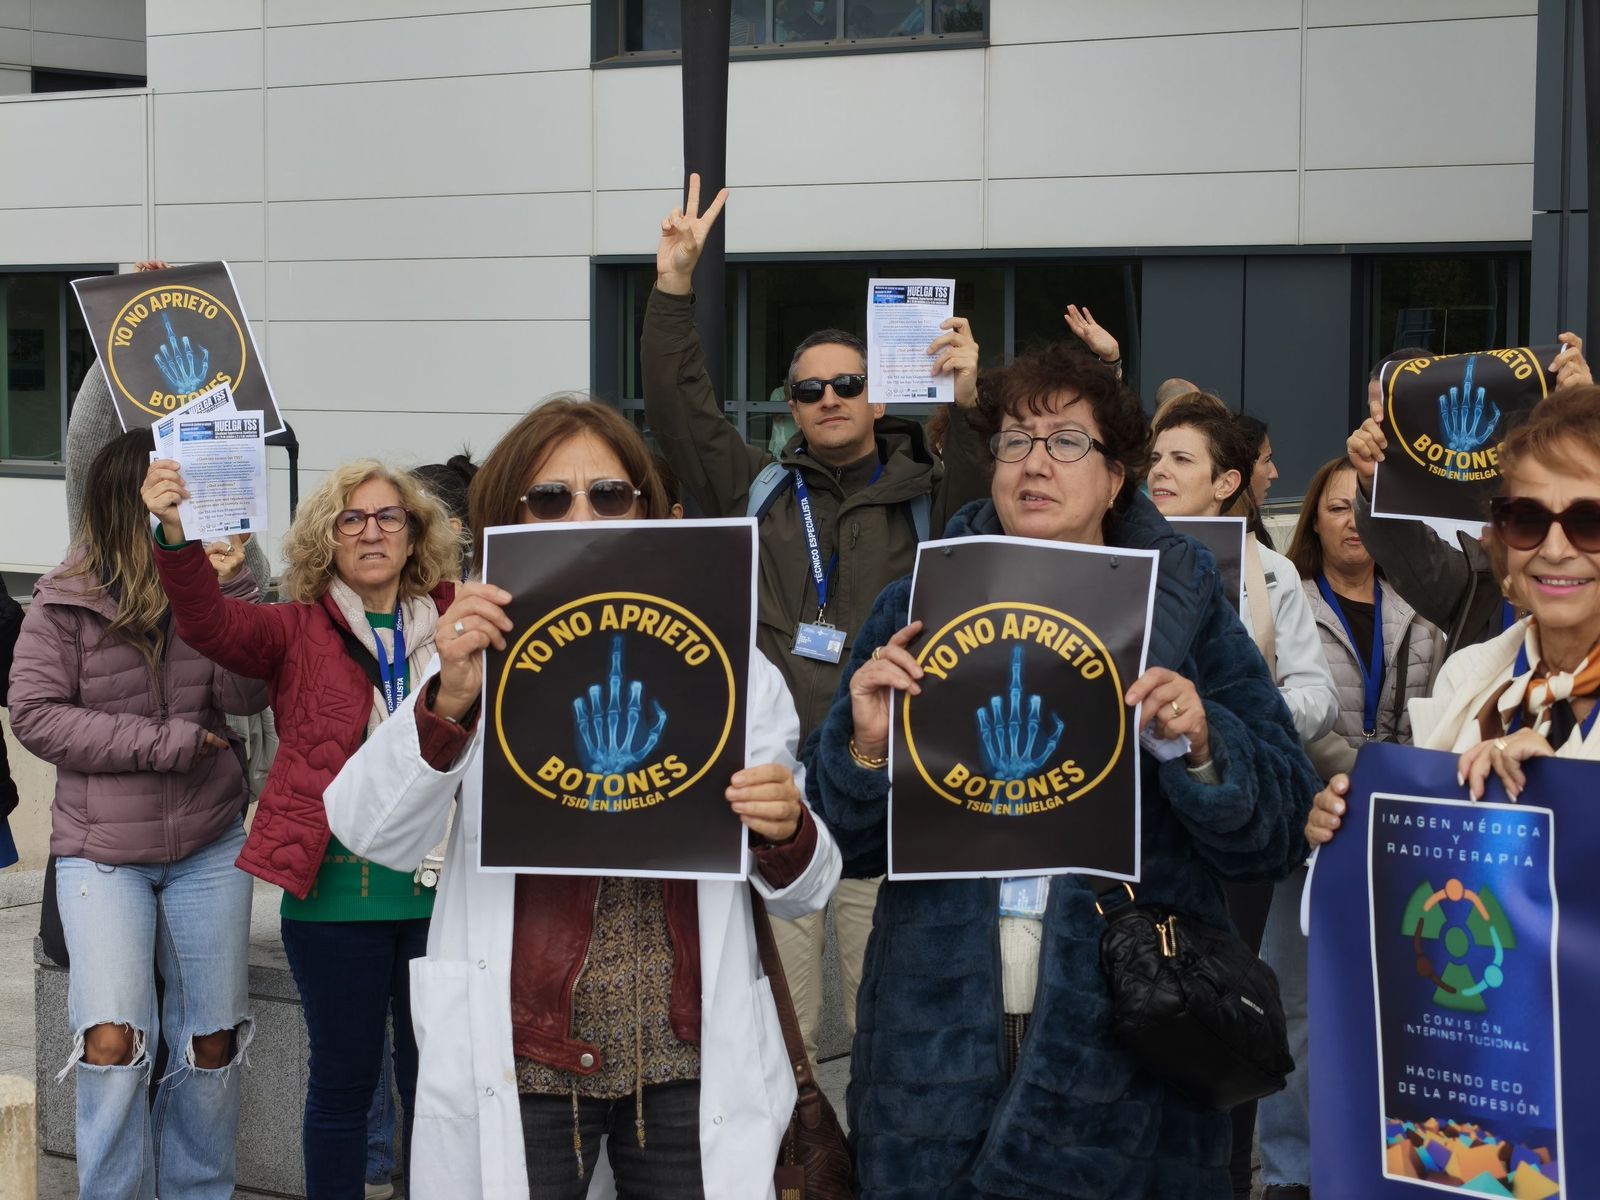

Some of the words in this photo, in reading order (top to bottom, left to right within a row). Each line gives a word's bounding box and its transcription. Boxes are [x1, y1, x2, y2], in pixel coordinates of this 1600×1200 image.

[907, 286, 933, 298] HUELGA
[935, 286, 948, 298] TSS
[114, 326, 134, 347] YO
[124, 303, 149, 328] NO
[149, 292, 219, 320] APRIETO
[1404, 358, 1431, 375] YO
[188, 399, 213, 415] HUELGA
[213, 390, 227, 405] TSS
[214, 420, 242, 432] HUELGA
[243, 419, 258, 431] TSS
[1413, 433, 1502, 470] BOTONE
[1428, 463, 1446, 477] TSID
[1448, 470, 1460, 480] EN
[1462, 469, 1498, 481] HUELGA
[800, 496, 818, 549] ESPECIALISTA
[810, 549, 824, 584] TÉCNICO
[515, 639, 553, 673] YO
[547, 611, 593, 648] NO
[599, 604, 711, 666] APRIETO
[924, 644, 959, 680] YO
[954, 617, 995, 655] NO
[1001, 613, 1105, 680] APRIETO
[384, 680, 394, 711] TÉCNICO
[536, 754, 688, 797] BOTONES
[943, 759, 1085, 801] BOTONES
[561, 794, 589, 810] TSID
[592, 799, 609, 811] EN
[612, 791, 665, 811] HUELGA
[965, 799, 993, 814] TSID
[995, 803, 1011, 815] EN
[1014, 795, 1064, 814] HUELGA
[1382, 813, 1451, 830] IMAGEN
[1462, 818, 1541, 838] MÉDICA
[1452, 834, 1460, 845] Y
[1387, 842, 1534, 867] RADIOTERAPIA
[1403, 1024, 1531, 1052] INTERINSTITUCIONAL
[1423, 1013, 1503, 1035] COMISIÓN
[1406, 1064, 1484, 1089] HACIENDO
[1491, 1079, 1524, 1095] ECO
[1398, 1081, 1417, 1095] DE
[1423, 1087, 1441, 1099] LA
[1448, 1090, 1540, 1116] PROFESIÓN
